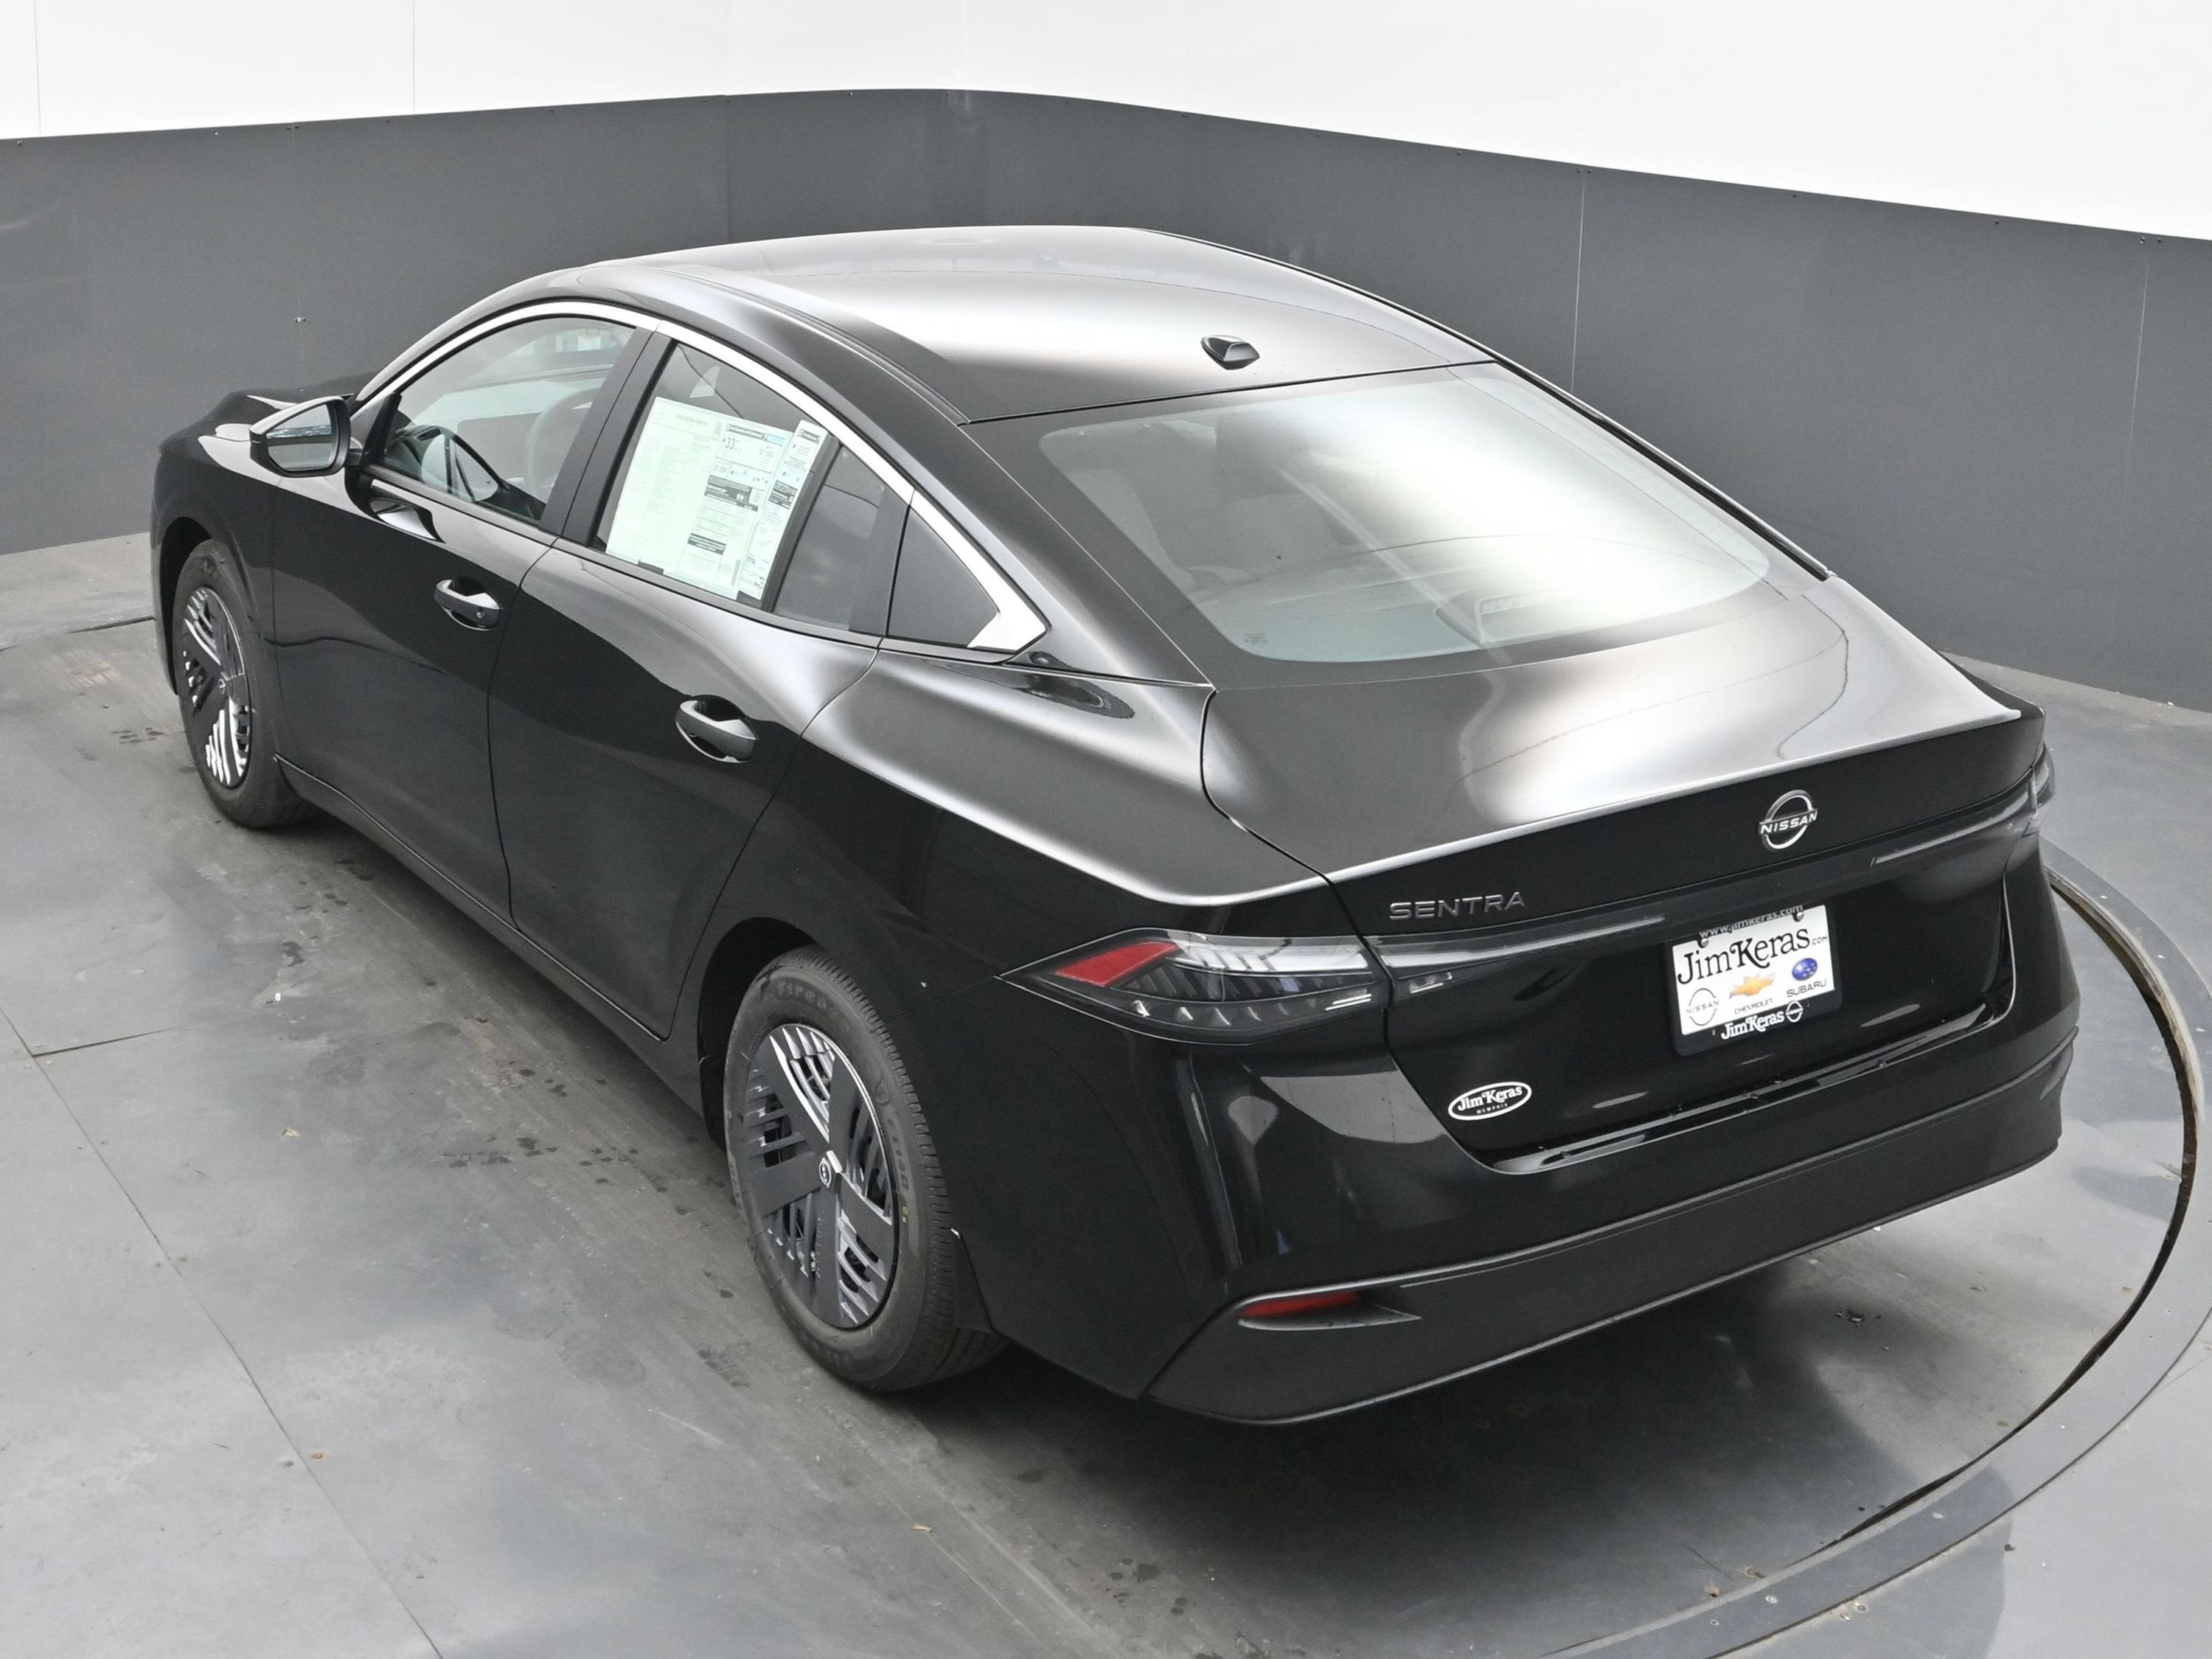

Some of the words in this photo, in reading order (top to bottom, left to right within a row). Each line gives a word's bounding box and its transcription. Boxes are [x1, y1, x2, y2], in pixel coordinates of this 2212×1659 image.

[1760, 811, 1818, 835] NISSAN
[1389, 891, 1525, 920] SENTRA
[1786, 978, 1827, 998] SUBARU
[1686, 999, 1719, 1015] NISSAN
[1734, 998, 1774, 1015] CHEVROLET
